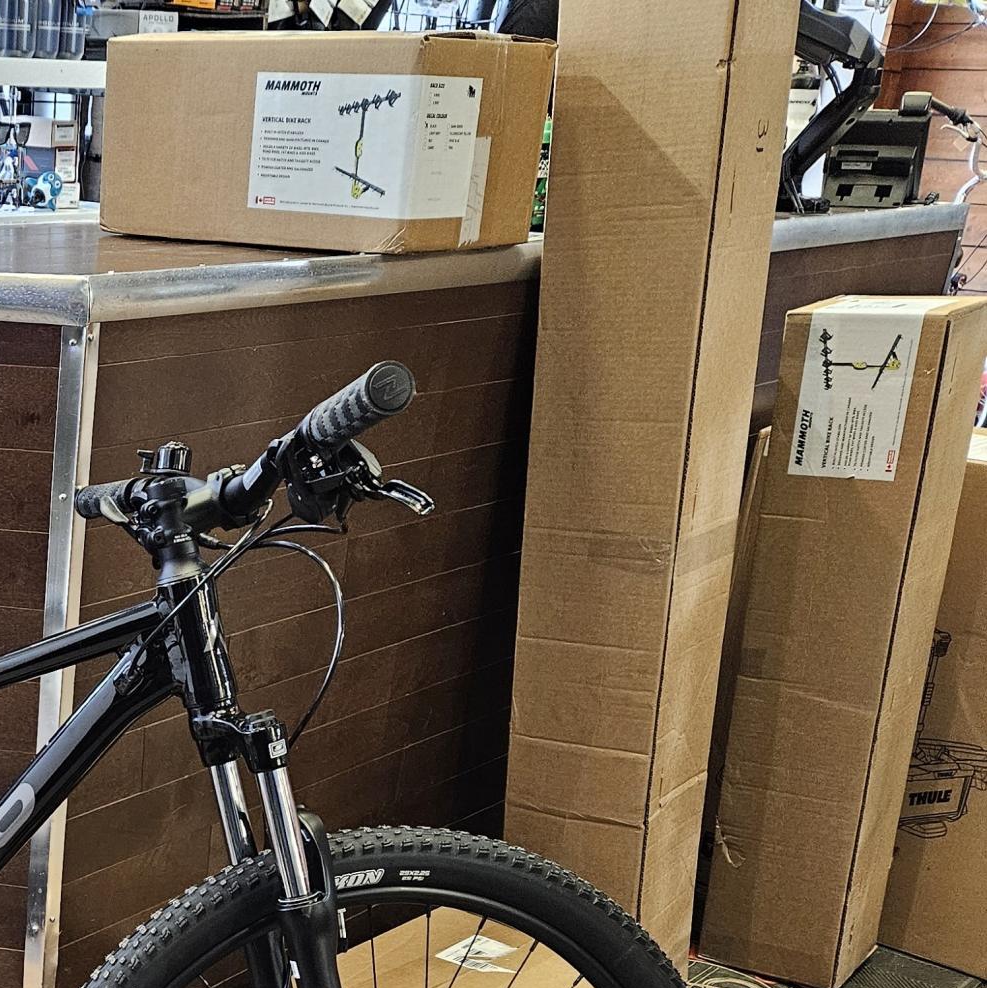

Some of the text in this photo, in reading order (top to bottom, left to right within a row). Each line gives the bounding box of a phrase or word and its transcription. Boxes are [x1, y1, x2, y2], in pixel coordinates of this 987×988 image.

[265, 80, 322, 91] MAMMOTH
[794, 408, 811, 467] MAMMOTH
[908, 789, 952, 806] THULE
